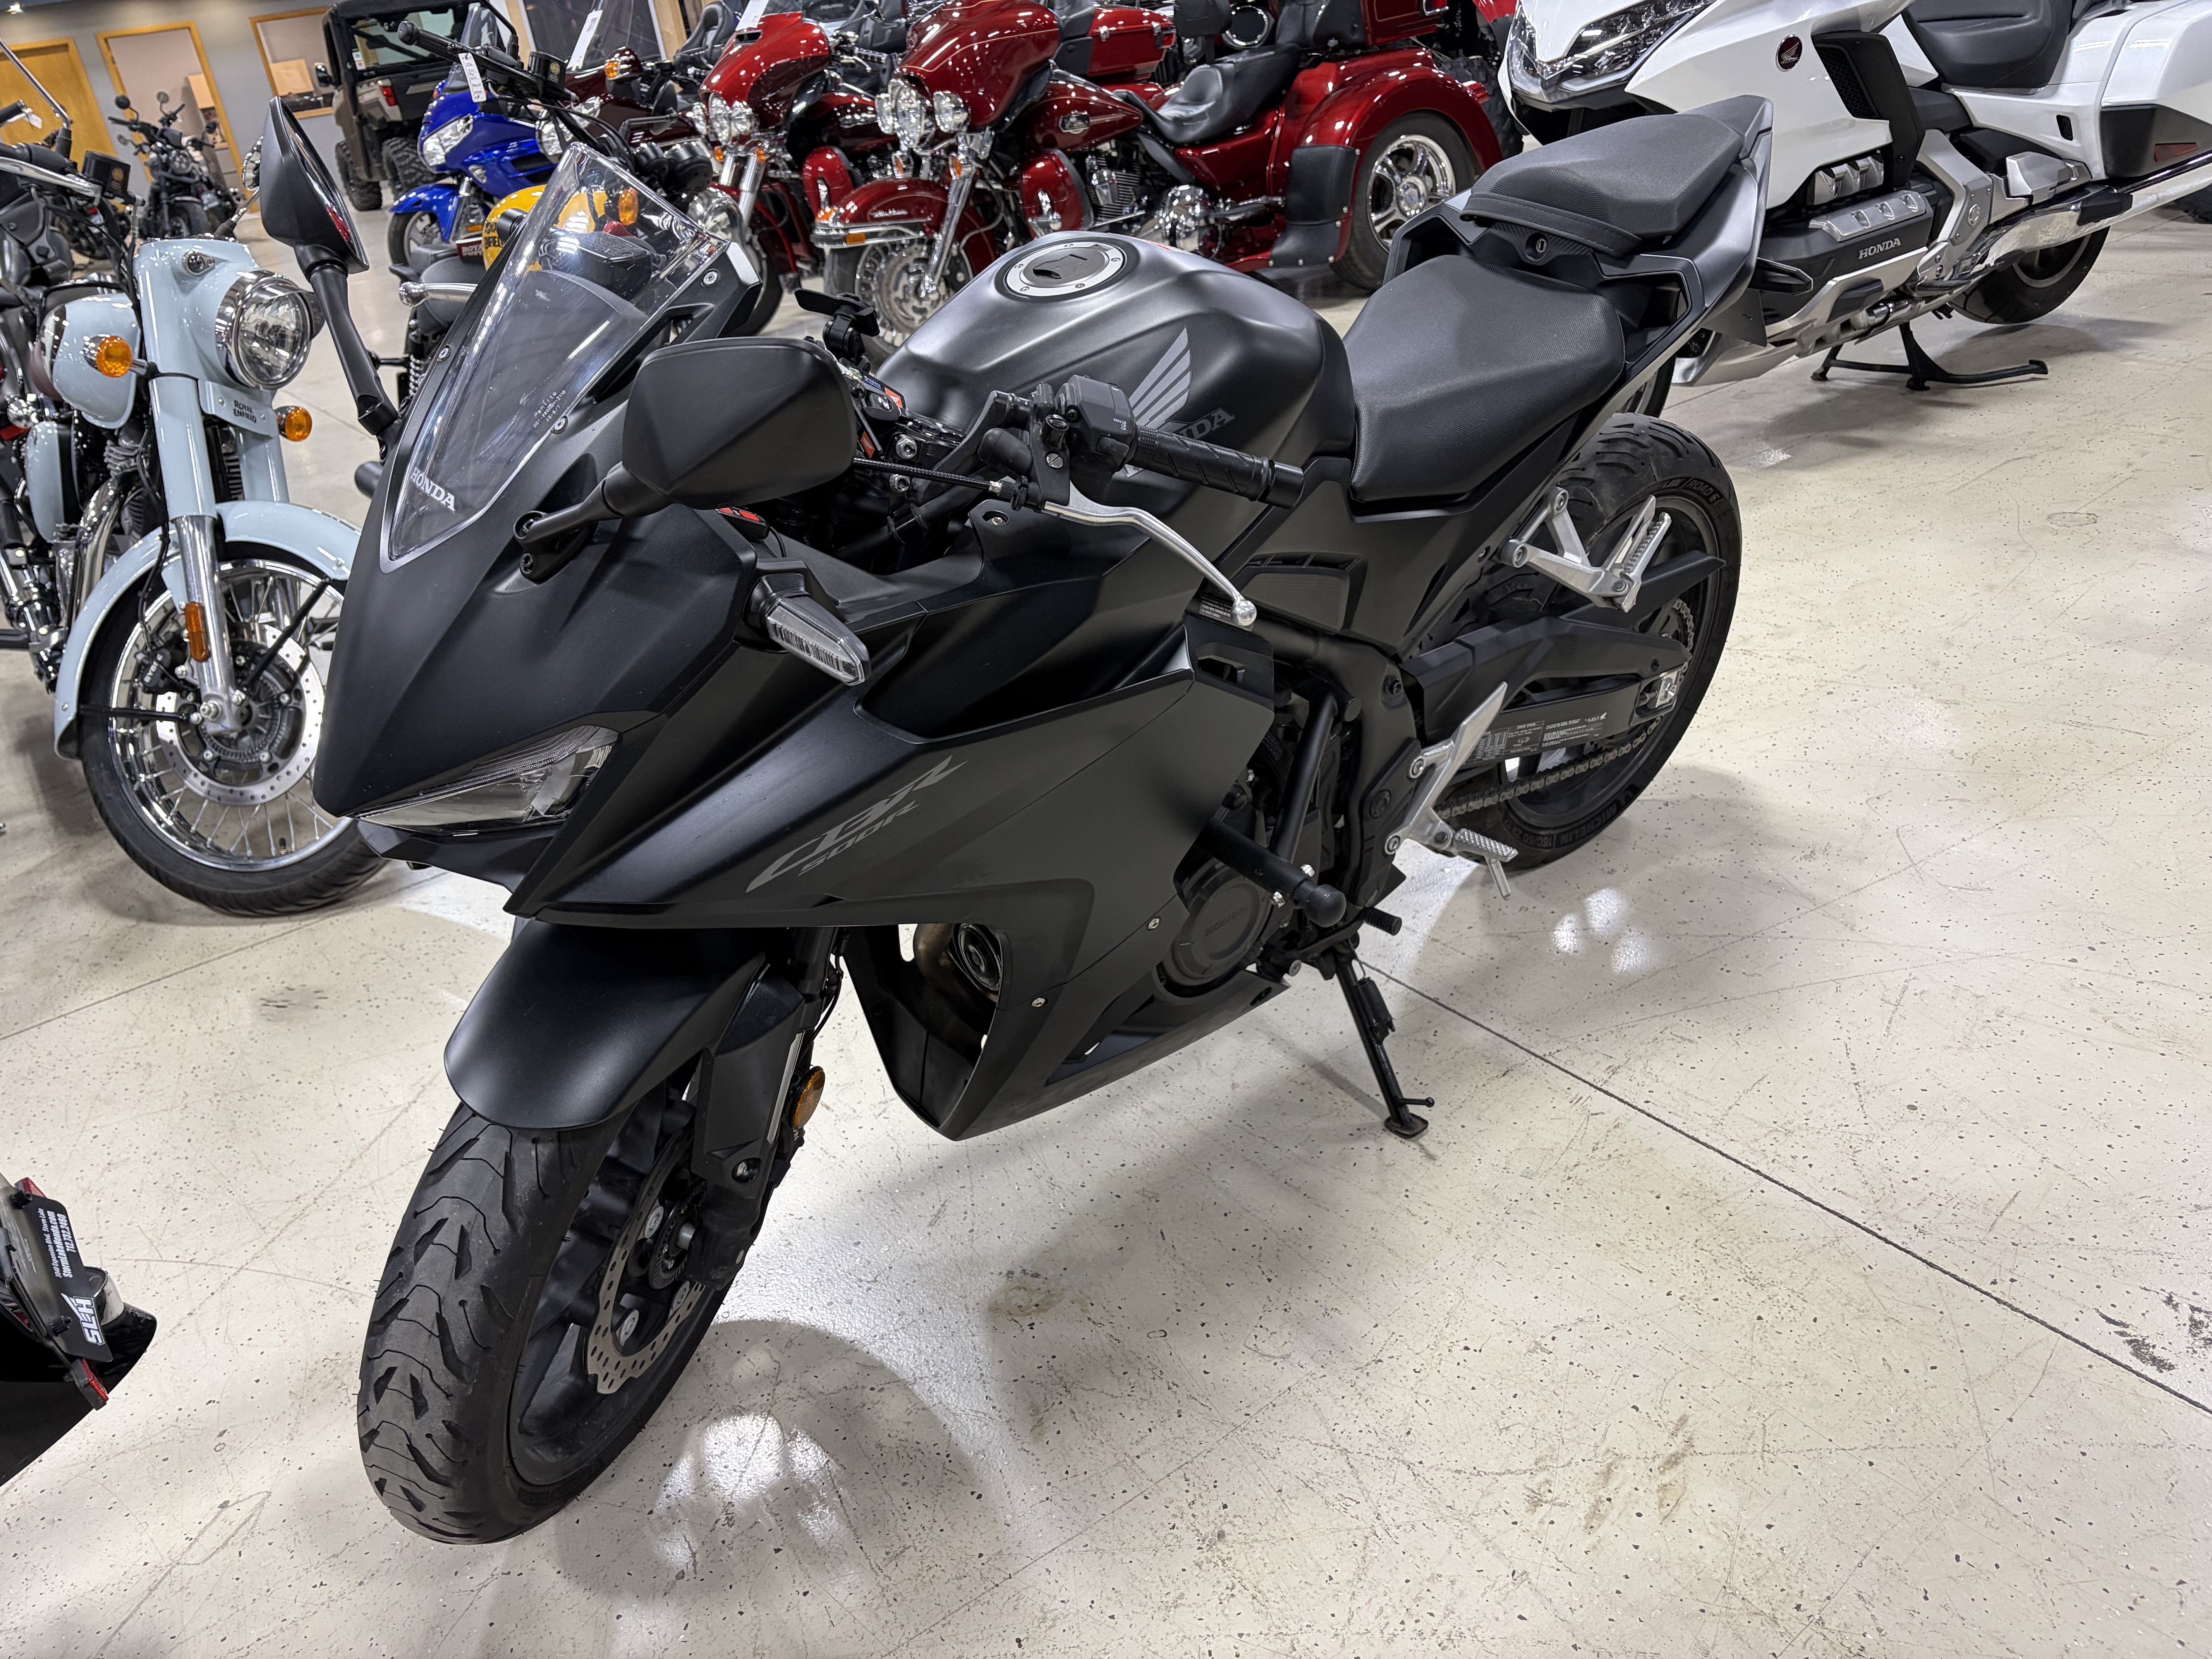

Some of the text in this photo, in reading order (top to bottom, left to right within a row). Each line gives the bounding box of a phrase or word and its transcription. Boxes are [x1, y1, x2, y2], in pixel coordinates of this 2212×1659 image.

[461, 244, 482, 252] ROYA
[1858, 237, 1901, 259] HONDA
[410, 467, 455, 512] HONDA
[1686, 478, 1714, 496] ROAD
[798, 800, 920, 876] 500R
[38, 1208, 46, 1218] Lake
[41, 1219, 50, 1232] Storm
[47, 1211, 73, 1278] StormLakeHonda.com
[71, 1295, 105, 1345] SLH
